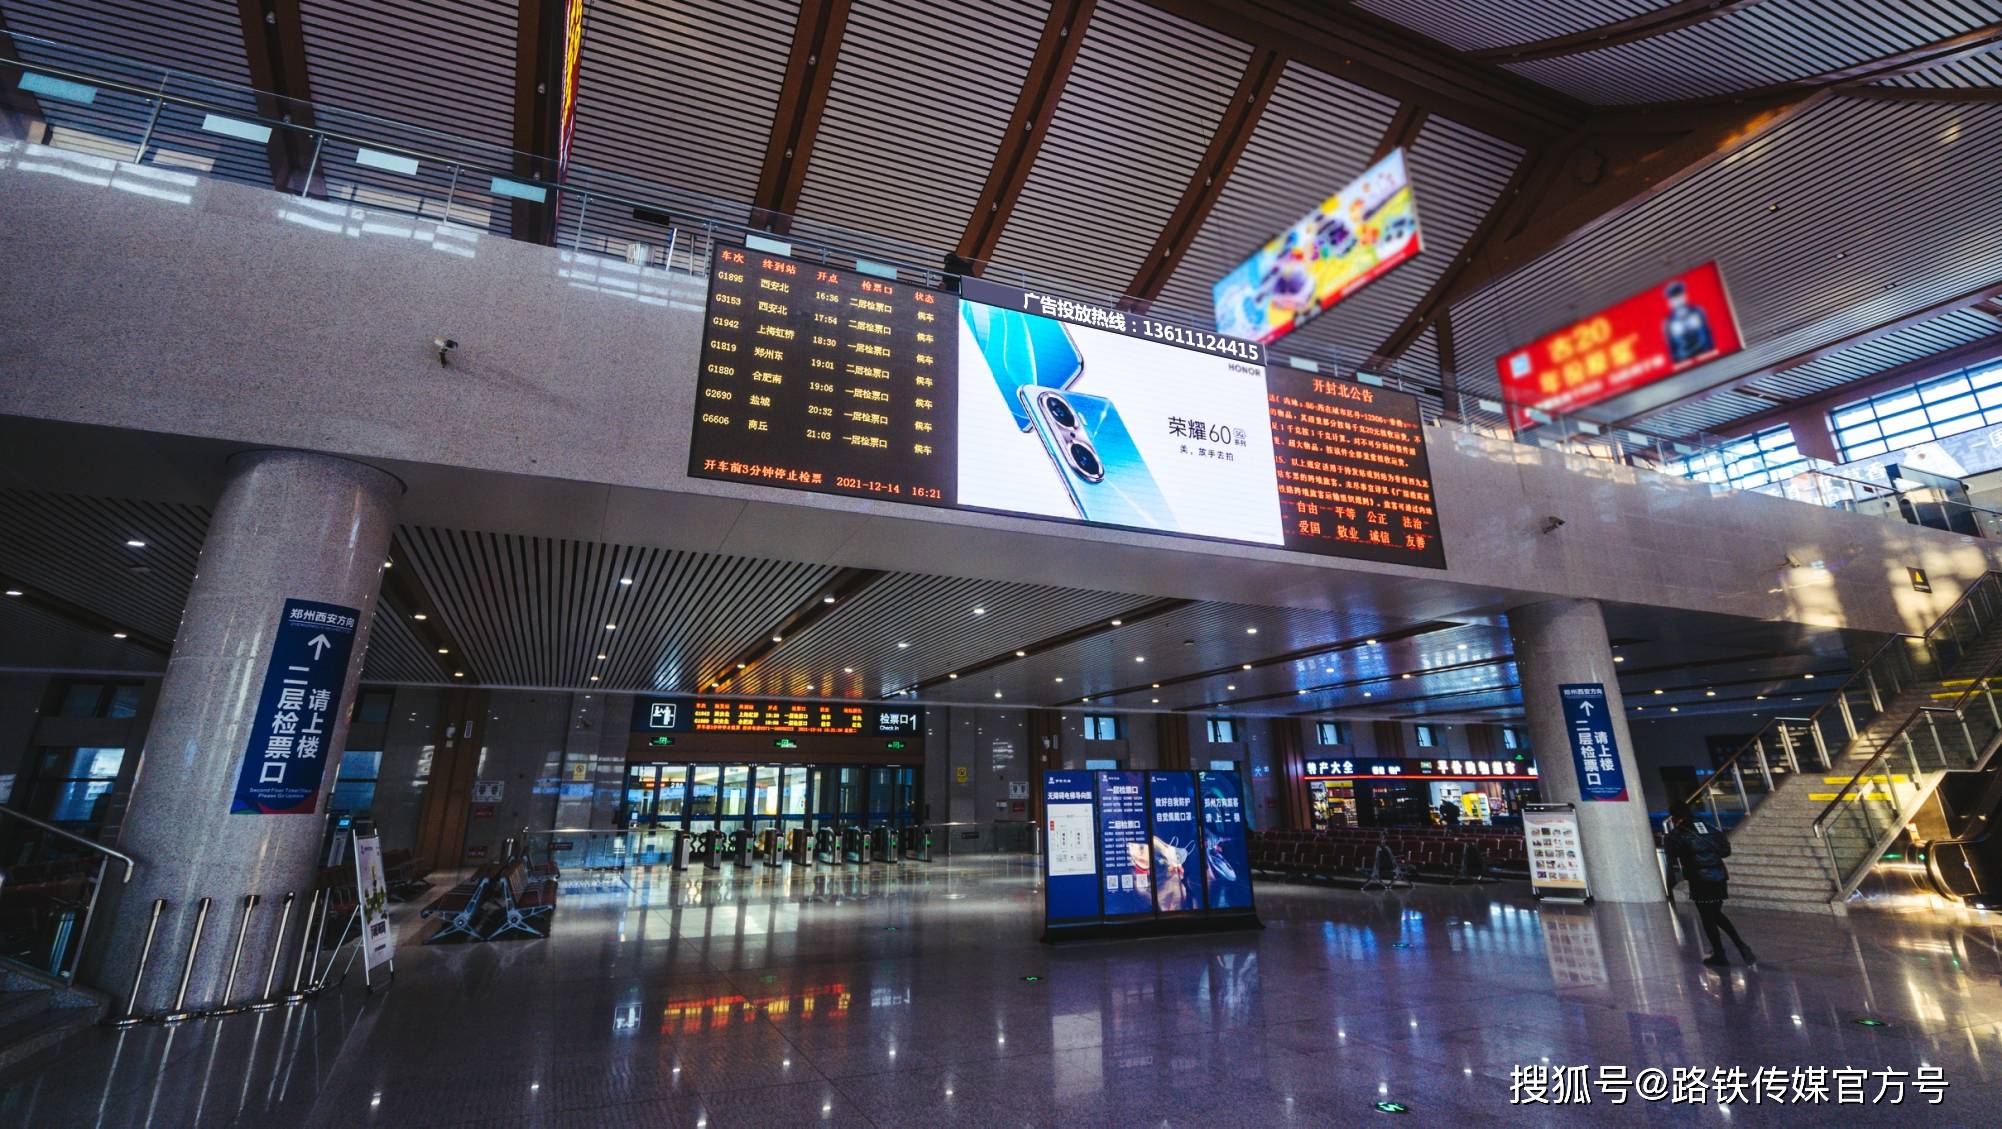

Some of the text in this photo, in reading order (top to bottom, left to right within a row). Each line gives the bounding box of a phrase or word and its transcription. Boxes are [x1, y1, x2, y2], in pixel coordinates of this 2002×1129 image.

[721, 250, 935, 304] 车次 终到站 开点 检票口 状态
[716, 293, 934, 344] G3153 西安北 17:54 二层检票口 候车
[760, 279, 790, 293] 西安北
[816, 292, 838, 302] 16:36
[849, 298, 892, 314] 二层检票口
[918, 311, 935, 323] 候车
[713, 316, 934, 366] G1942 上海虹桥 18:30 一层检票口 候车
[1023, 292, 1259, 361] 广告投放热线：13611124415
[710, 340, 934, 388] G1819 郑州东 19:01 二层检票口 候车
[1228, 363, 1261, 376] HONOR
[705, 388, 932, 432] G2690 盐城 20:32 一层检票口 候车
[752, 371, 783, 385] 合肥南
[810, 382, 834, 393] 19:06
[845, 387, 889, 402] 一层检票口
[915, 398, 933, 410] 候车
[1312, 378, 1374, 404] 开封北公告
[702, 414, 932, 456] G6606 商丘 21:03 一层检票口 候车
[1168, 416, 1231, 444] 荣耀60
[704, 458, 942, 500] 开车前3分钟停止检票 2021-12-14 16:21
[1298, 500, 1423, 530] 自由 平等 公正 法治
[1299, 520, 1425, 549] 爱国 敬业 诚信 友善
[290, 608, 355, 628] 郑州西安方向
[259, 665, 310, 784] 二层检票口
[296, 688, 331, 760] 请上楼
[1306, 760, 1354, 774] 特产大全
[1576, 720, 1602, 786] 二层检票口
[1594, 731, 1616, 772] 请上楼
